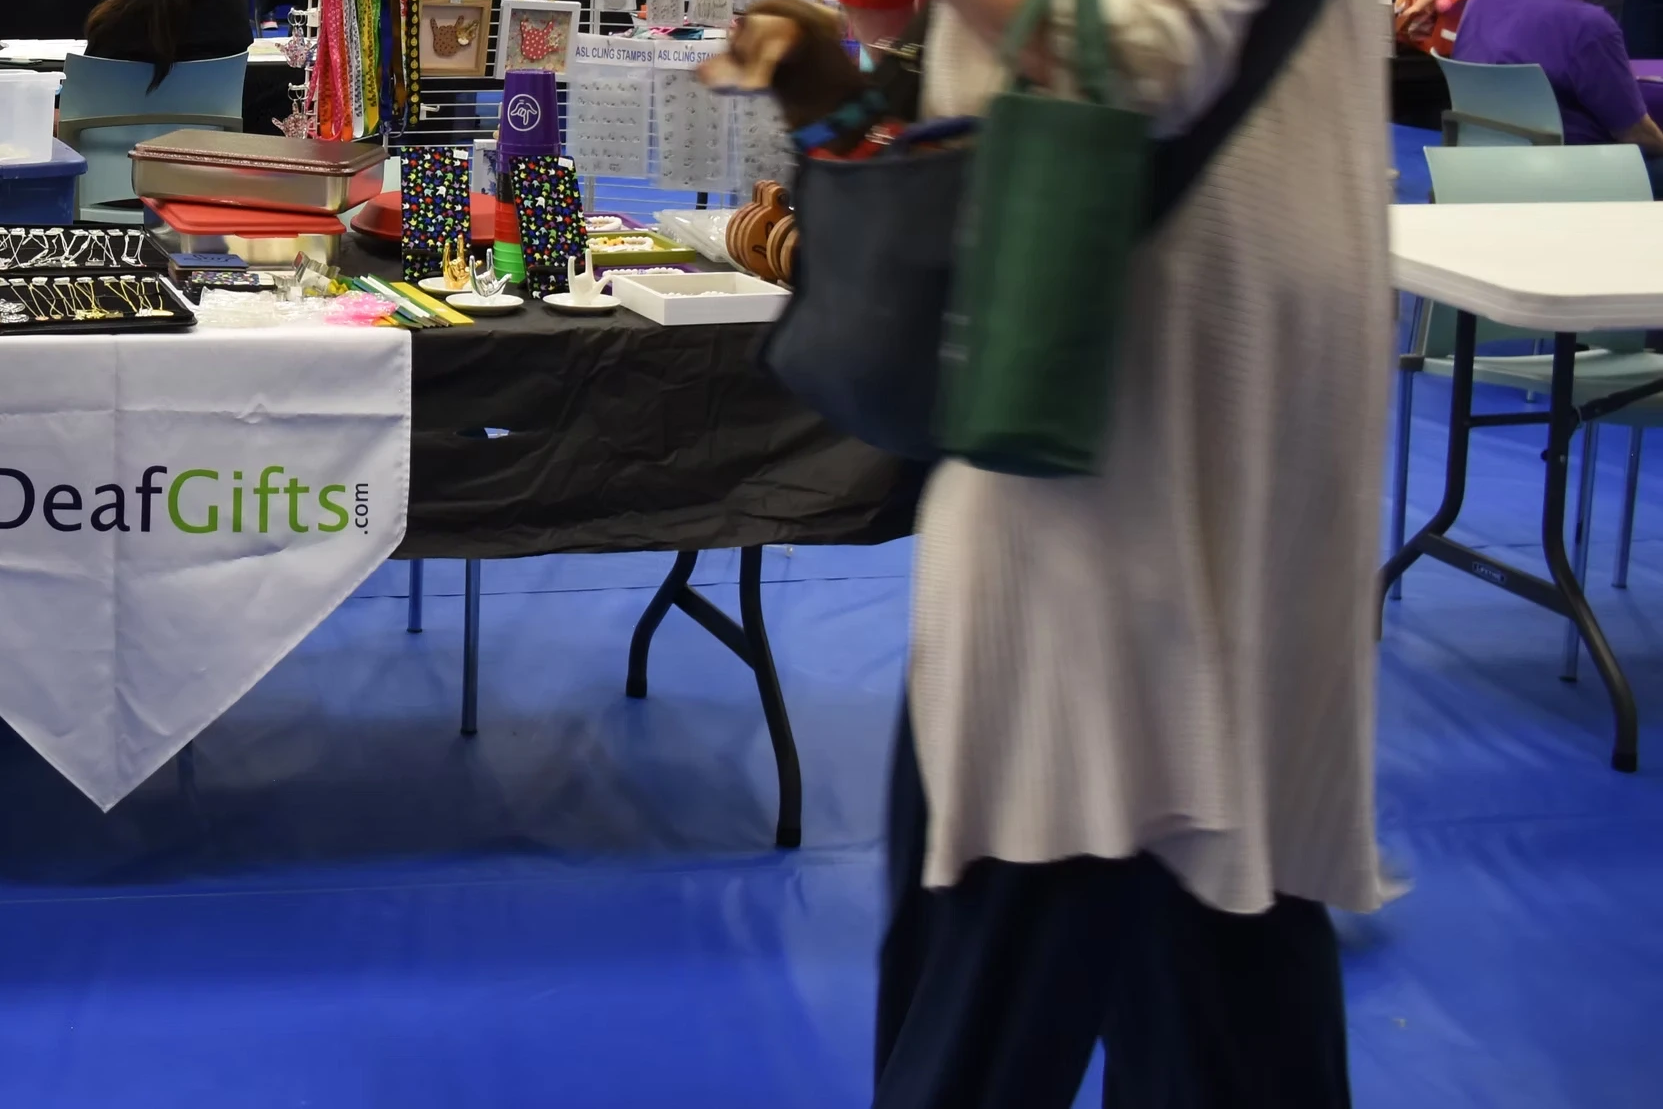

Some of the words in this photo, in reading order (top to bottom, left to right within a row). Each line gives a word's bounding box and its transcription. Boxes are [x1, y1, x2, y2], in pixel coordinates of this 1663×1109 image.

[575, 46, 590, 58] ASL
[591, 47, 615, 60] CLING
[658, 49, 671, 61] ASL
[672, 50, 695, 62] CLING
[354, 482, 369, 535] .com
